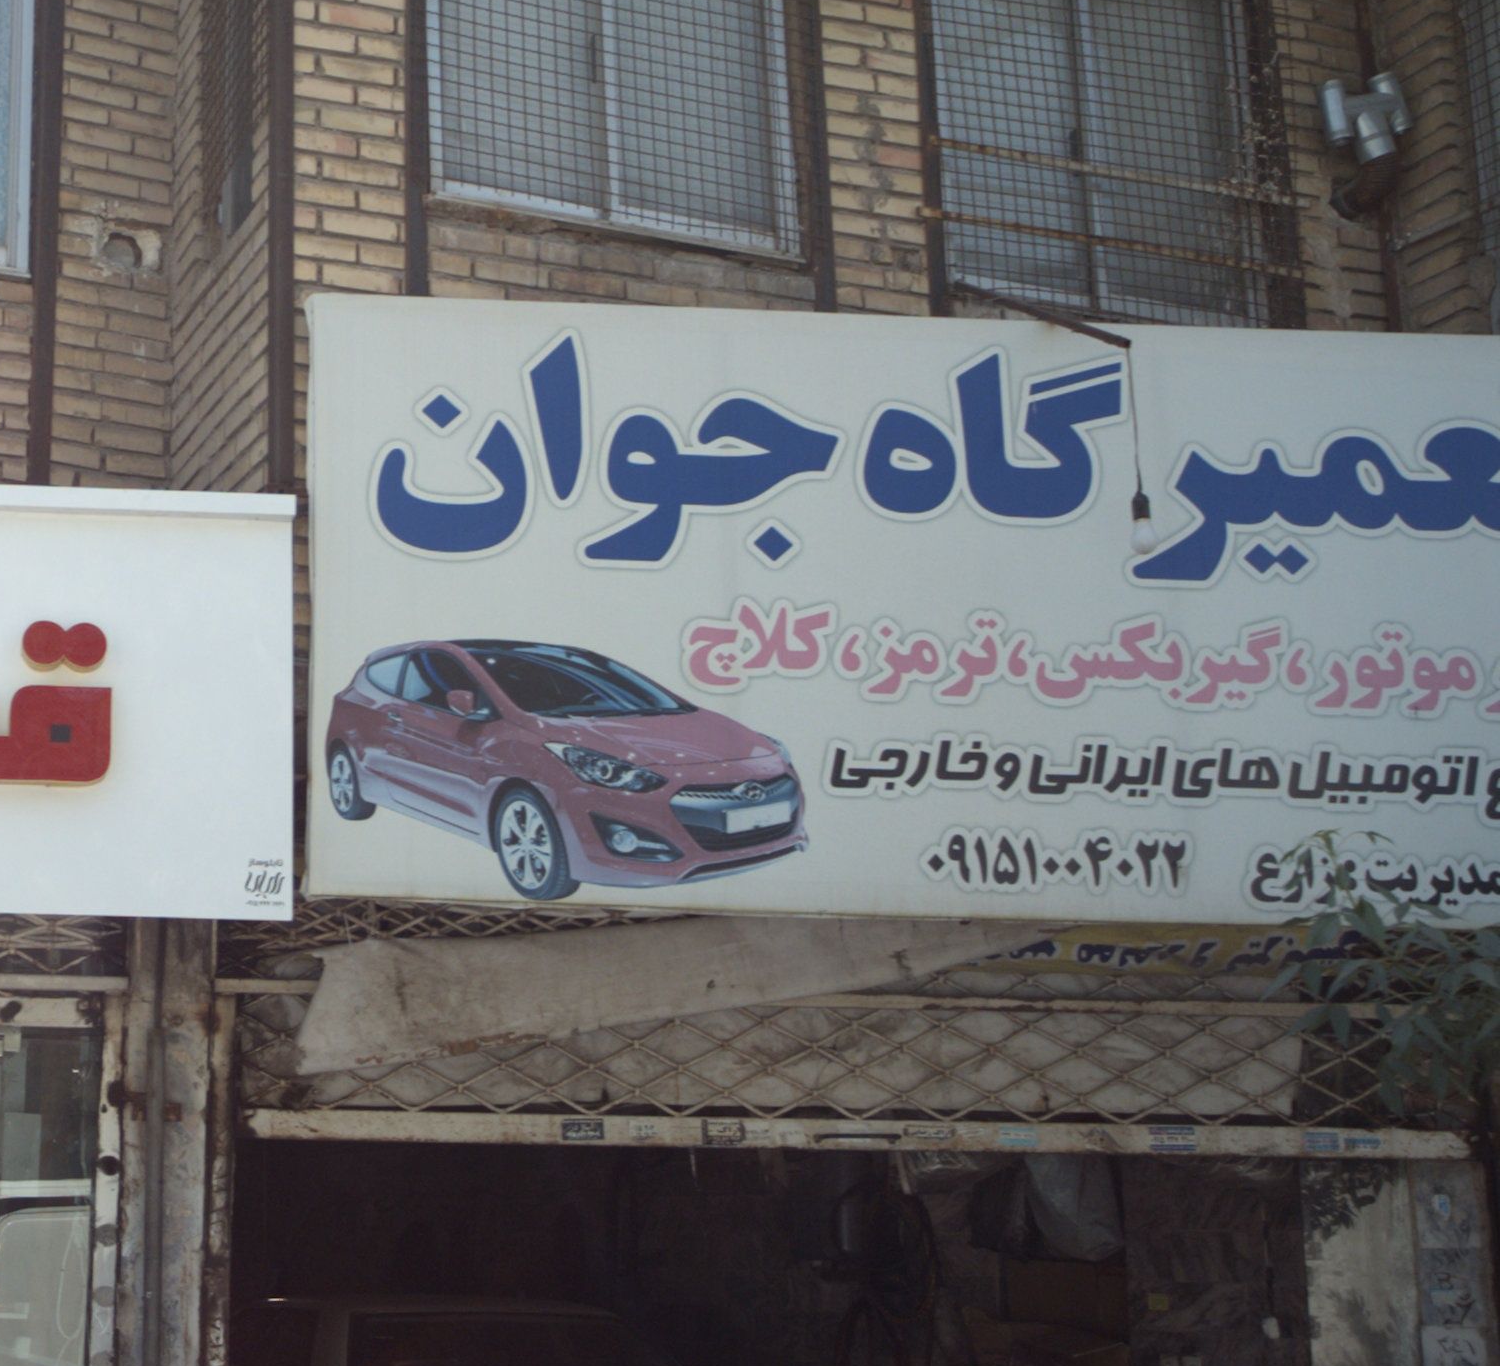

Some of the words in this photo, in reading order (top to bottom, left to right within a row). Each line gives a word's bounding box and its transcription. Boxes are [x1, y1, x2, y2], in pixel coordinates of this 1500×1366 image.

[377, 335, 840, 561] جوان
[864, 353, 1500, 582] عمیرگاه
[688, 604, 831, 688] کلاچ
[1027, 741, 1168, 799] ایرانی
[1287, 749, 1480, 805] اتومبیل
[927, 833, 1187, 889] ۰۹۱۵۱۰۰۴۰۲۲
